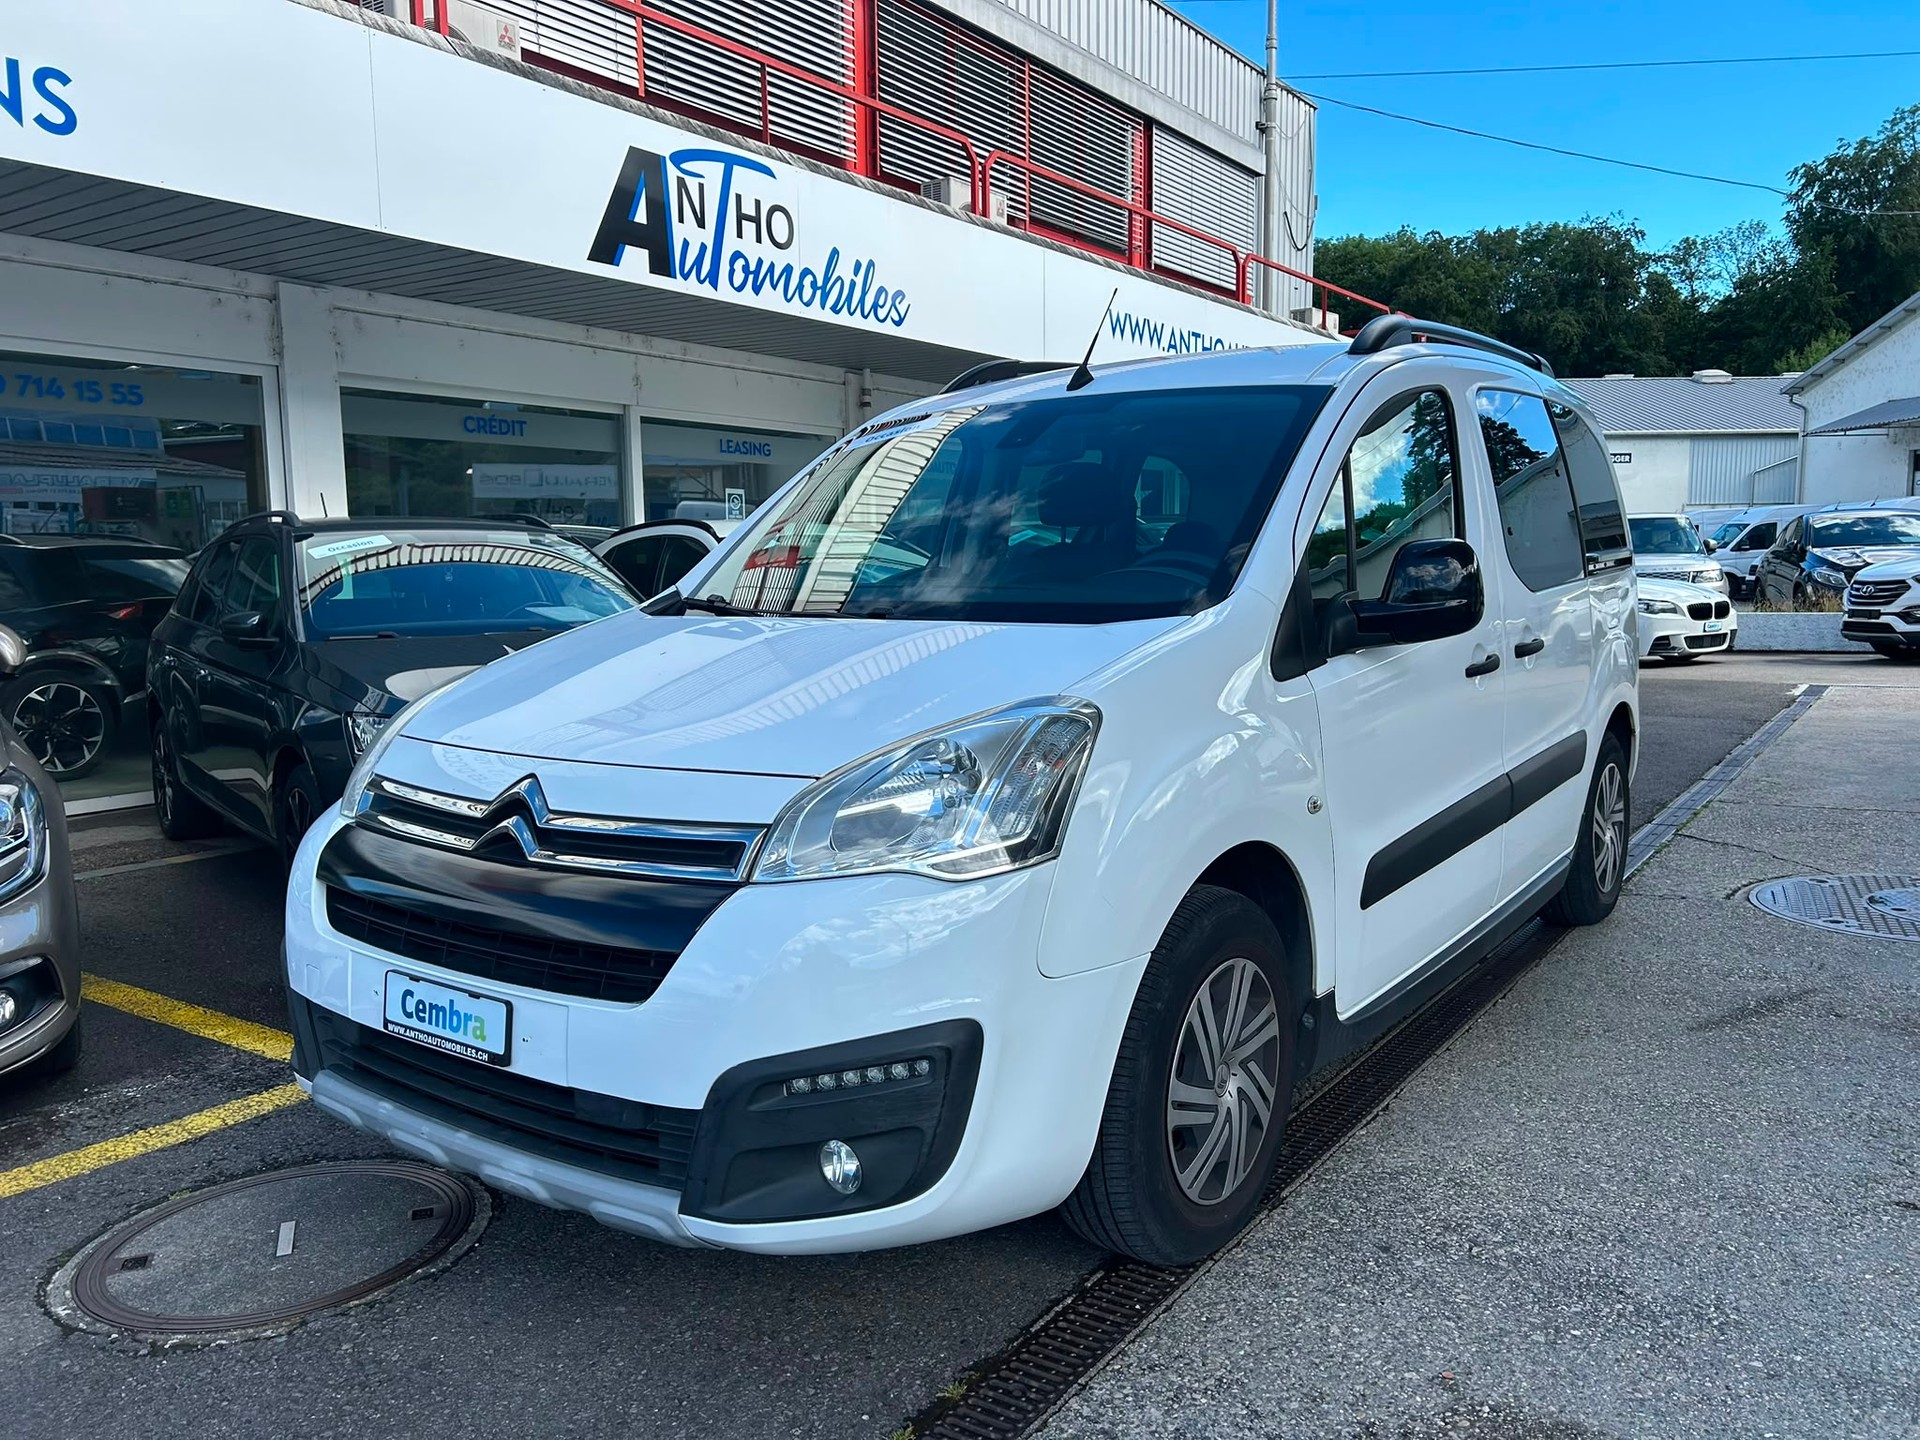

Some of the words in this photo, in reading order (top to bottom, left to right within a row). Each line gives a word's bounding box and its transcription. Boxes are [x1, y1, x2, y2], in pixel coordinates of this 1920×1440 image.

[1109, 309, 1251, 354] WWW.ANTHO
[15, 374, 66, 399] 714
[72, 380, 103, 404] 15
[111, 383, 144, 406] 55
[463, 415, 527, 437] CRÉDIT
[719, 439, 772, 457] LEASING
[328, 540, 374, 553] Occasion
[401, 988, 487, 1042] Cembra
[387, 1022, 489, 1062] WWW.ANTHOAUTOMOBILES.CH
